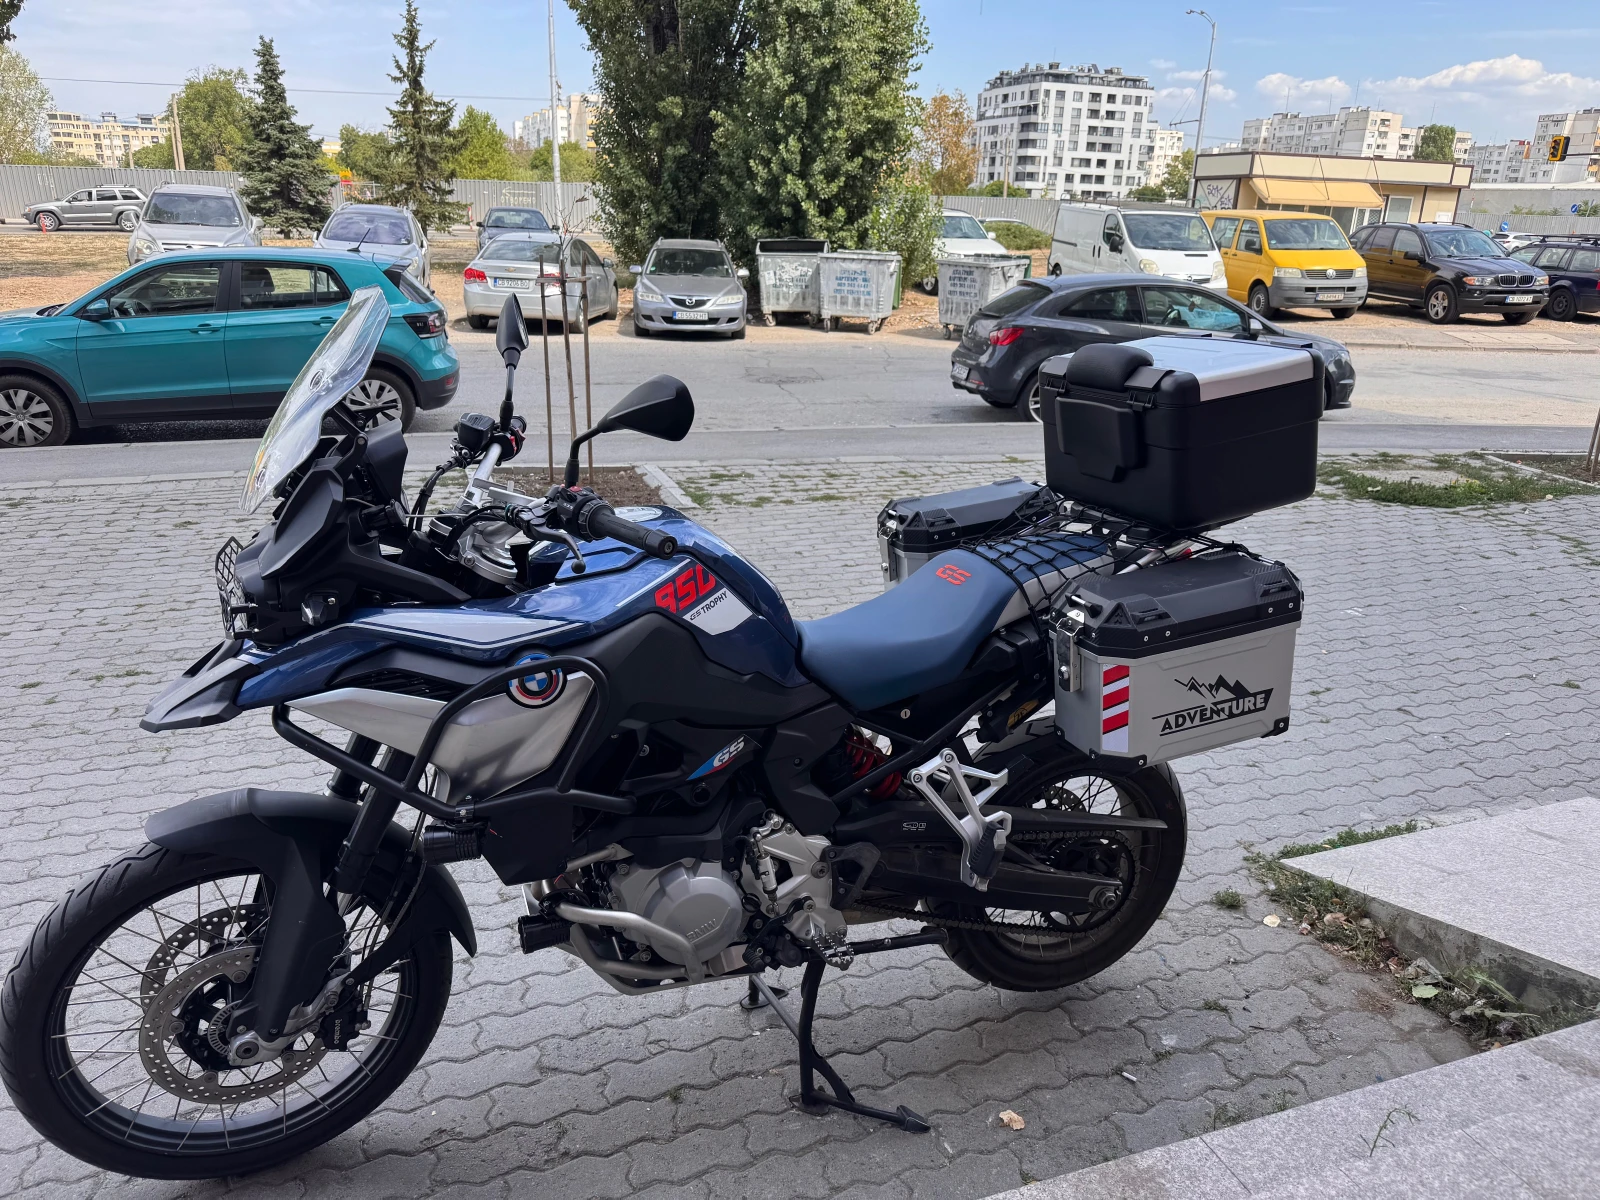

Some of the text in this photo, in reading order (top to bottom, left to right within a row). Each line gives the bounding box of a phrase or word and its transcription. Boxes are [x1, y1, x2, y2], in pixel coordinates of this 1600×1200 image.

[935, 564, 972, 586] GS
[689, 590, 728, 621] GS TROPHY
[1160, 693, 1266, 733] ADVENTURE
[712, 735, 745, 767] GS
[686, 918, 717, 942] BMW
[333, 1018, 342, 1045] brembo
